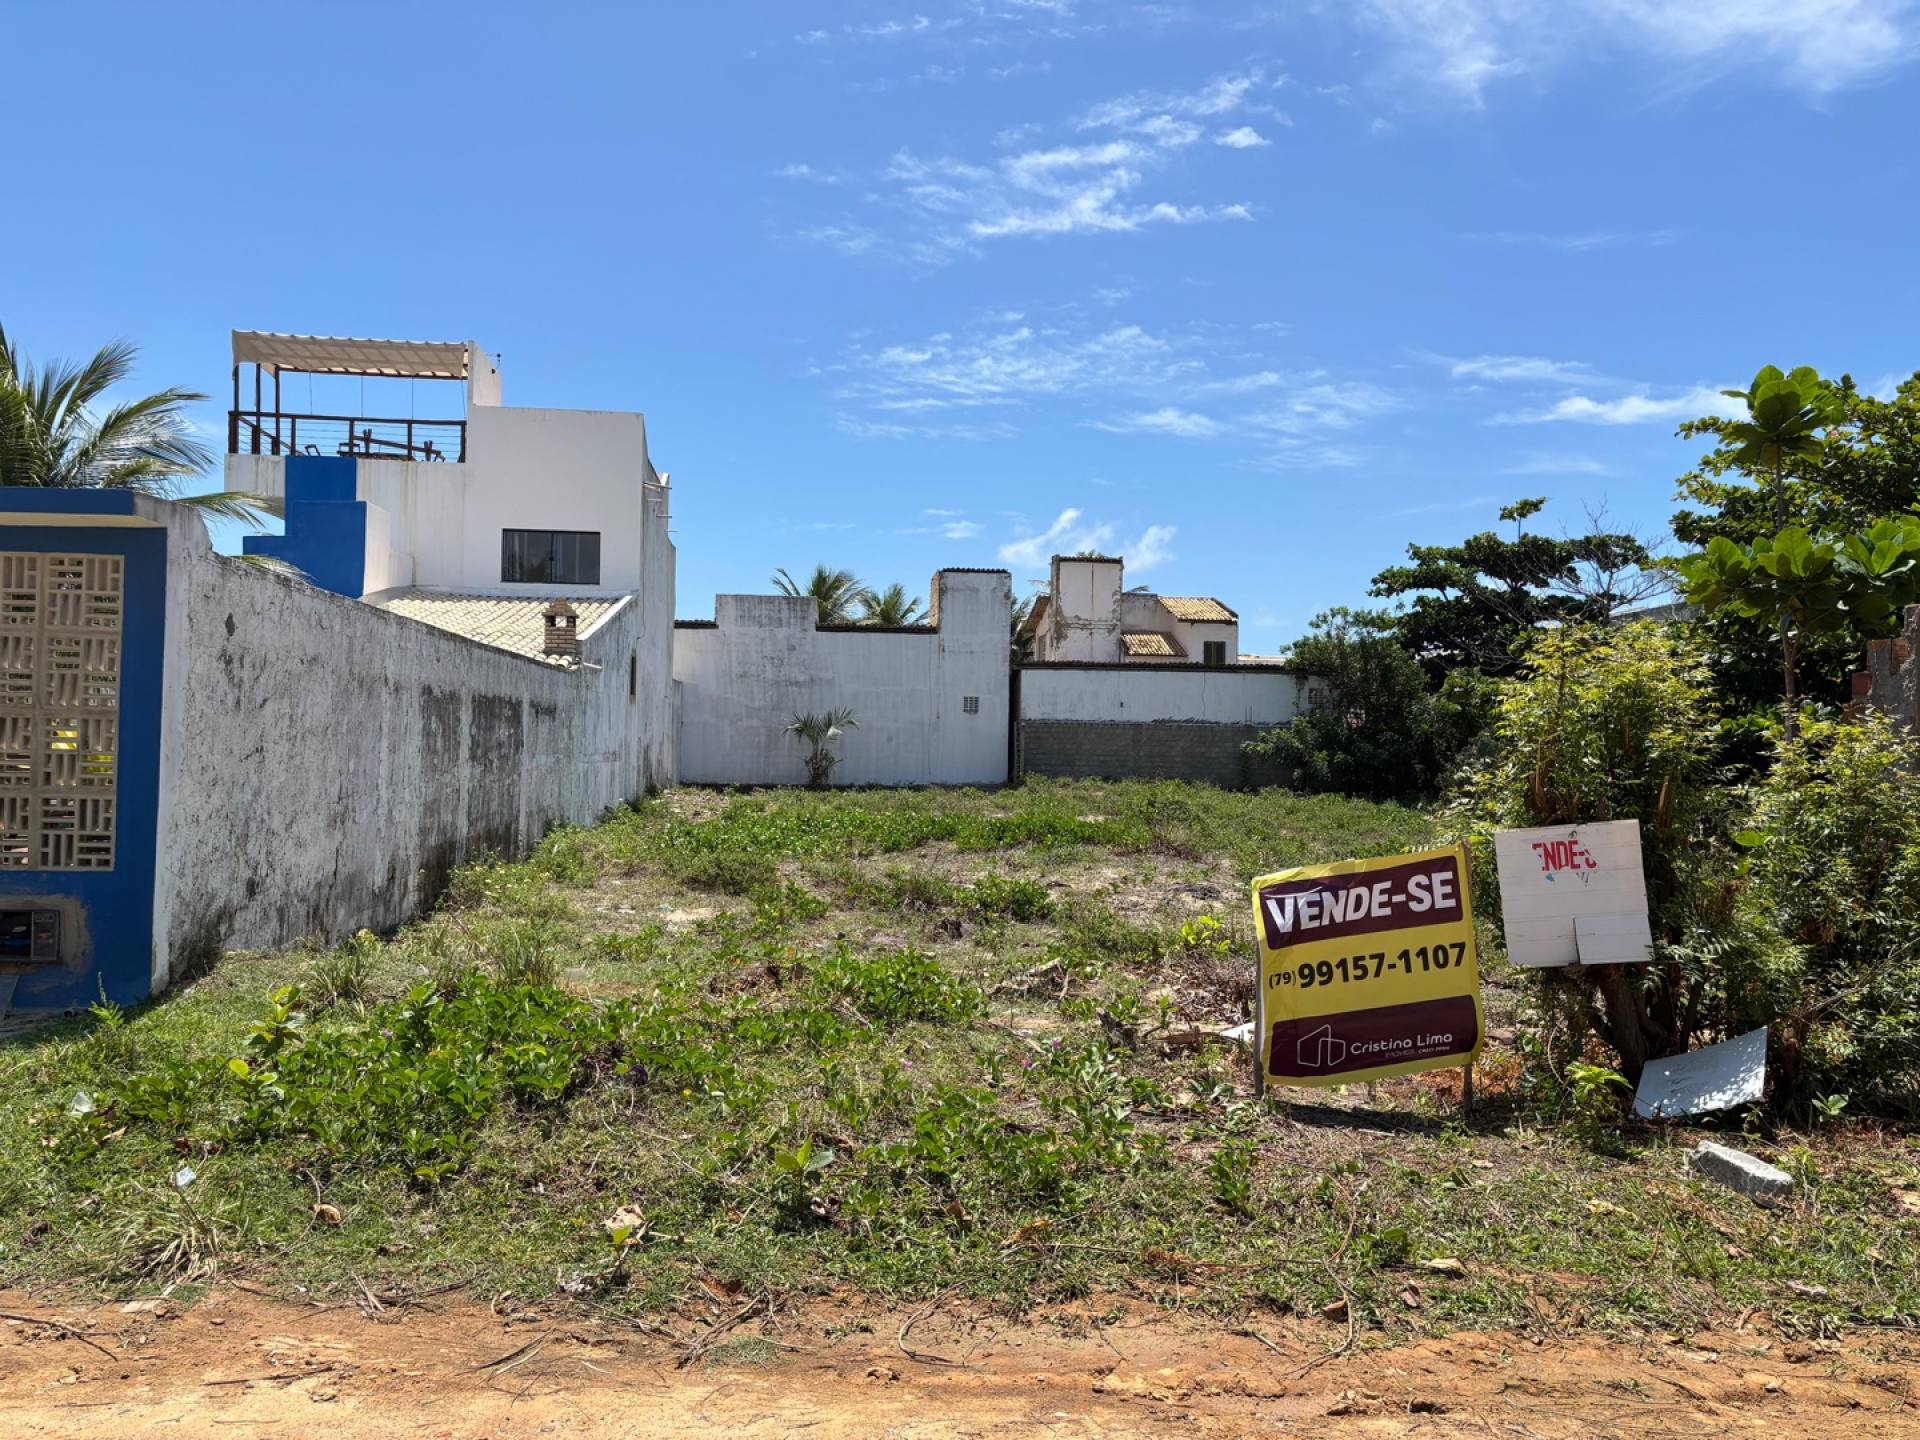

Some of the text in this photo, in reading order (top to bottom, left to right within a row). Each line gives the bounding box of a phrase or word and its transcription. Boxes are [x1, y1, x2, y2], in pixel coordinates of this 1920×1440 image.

[1264, 871, 1457, 933] VENDE-SE
[1298, 942, 1466, 989] 99157-1107
[1350, 1038, 1413, 1054] Cristina
[1417, 1033, 1453, 1046] Lima
